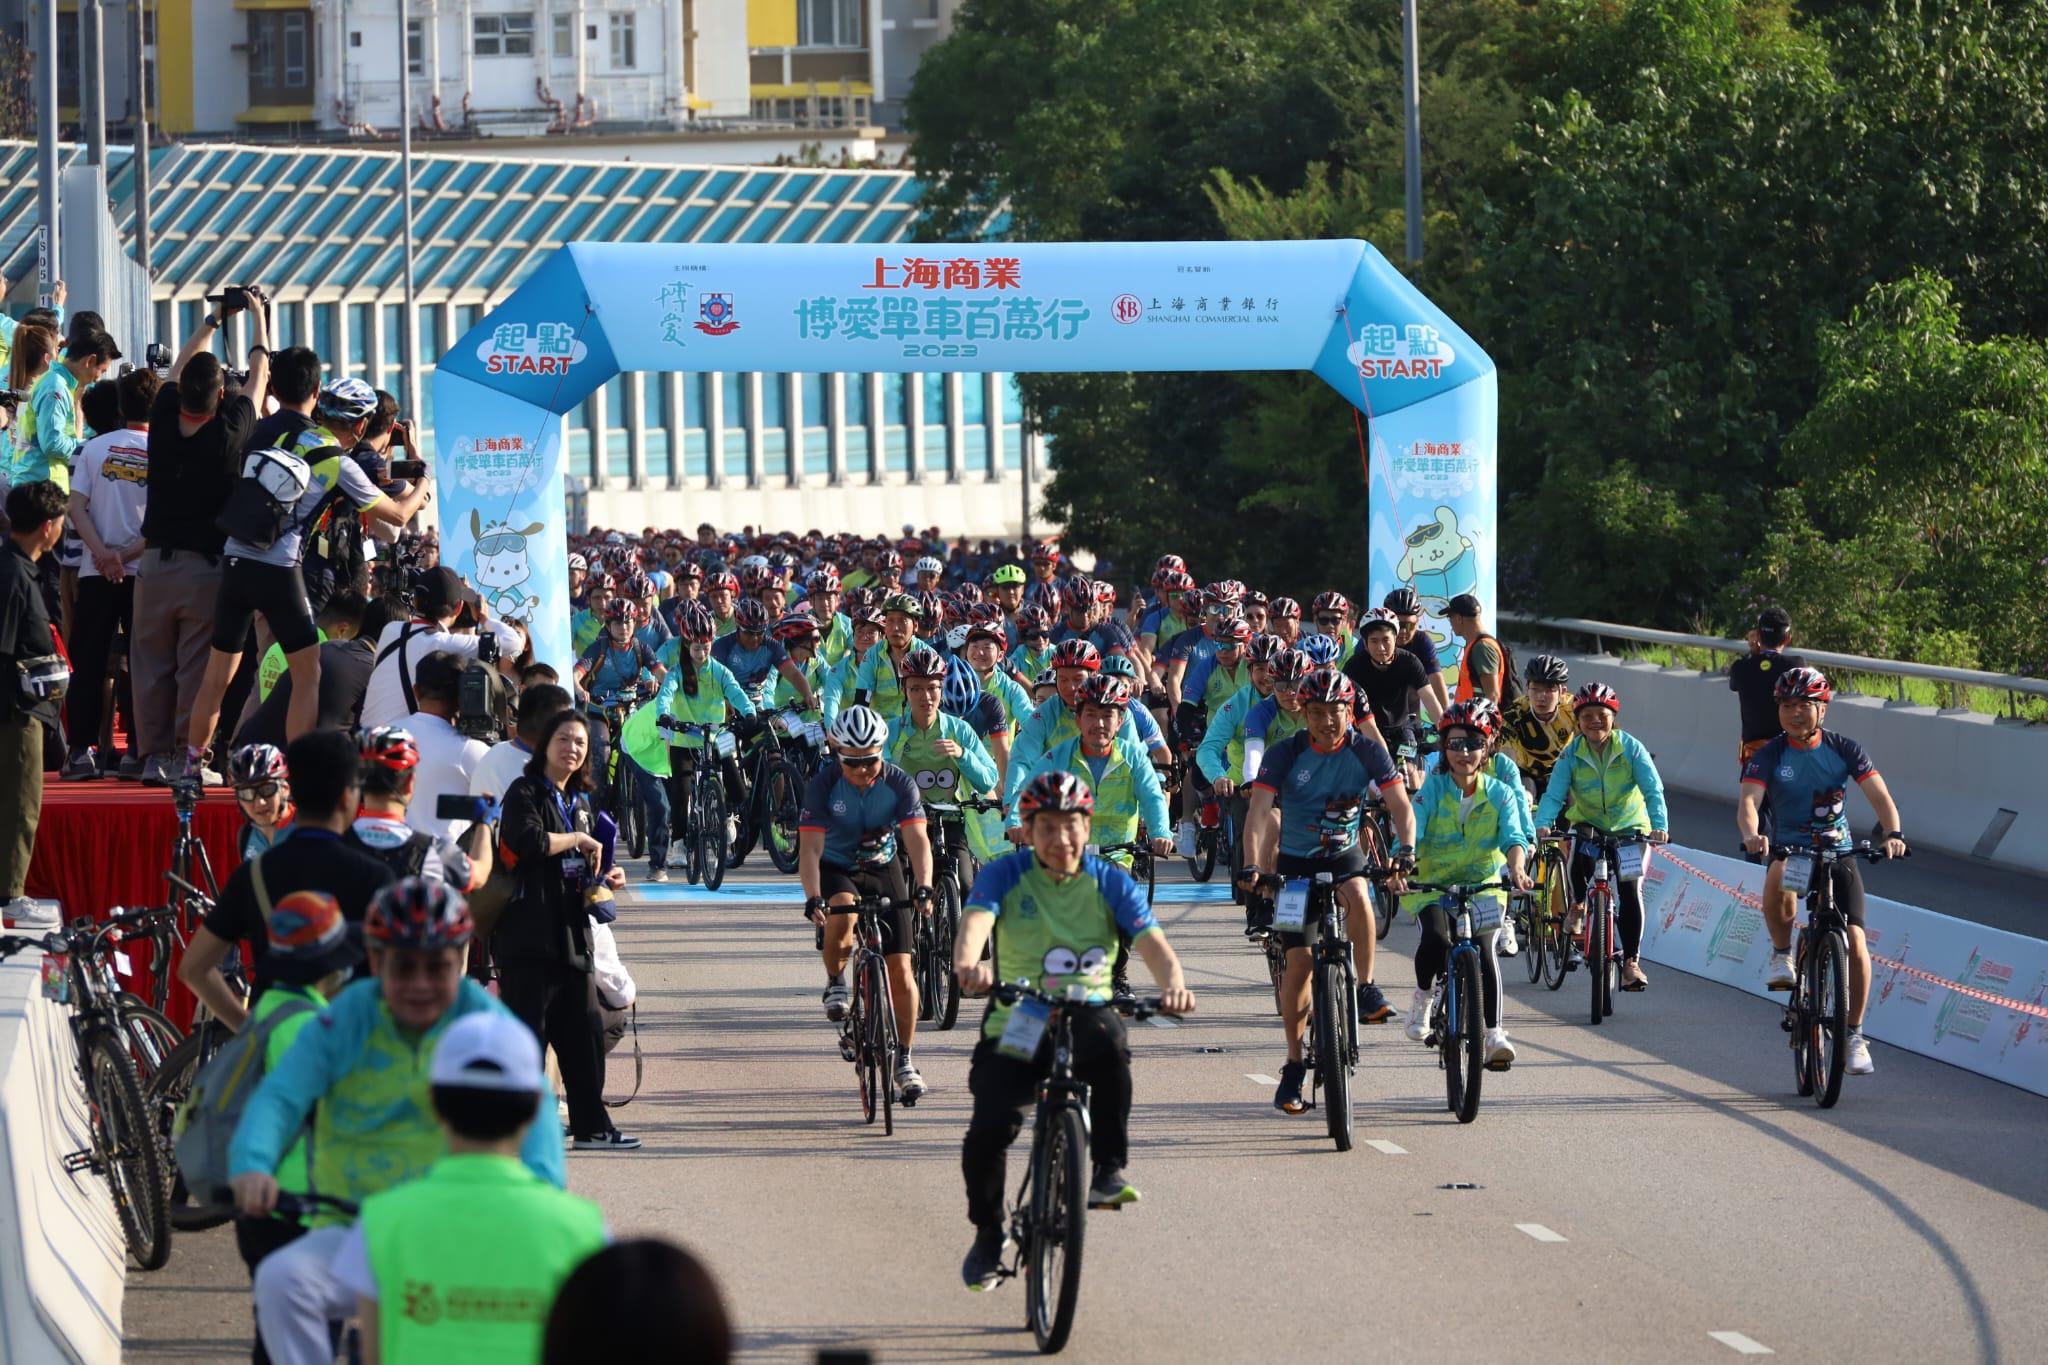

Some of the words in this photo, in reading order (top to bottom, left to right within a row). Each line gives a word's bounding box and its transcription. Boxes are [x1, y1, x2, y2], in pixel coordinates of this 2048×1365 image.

[862, 258, 1021, 289] 上海商業
[1147, 296, 1279, 311] 上海商業銀行
[793, 296, 1090, 341] 博愛單車百萬行
[1147, 315, 1191, 323] SHANGHAI
[1195, 315, 1250, 323] COMMERCIAL
[1256, 315, 1279, 323] BANK
[493, 325, 572, 354] 起點
[1363, 326, 1438, 356] 起點
[903, 344, 978, 357] 2023
[487, 355, 573, 375] START
[1361, 358, 1443, 378] START
[473, 438, 523, 452] 上海商業
[1411, 442, 1462, 456] 上海商業
